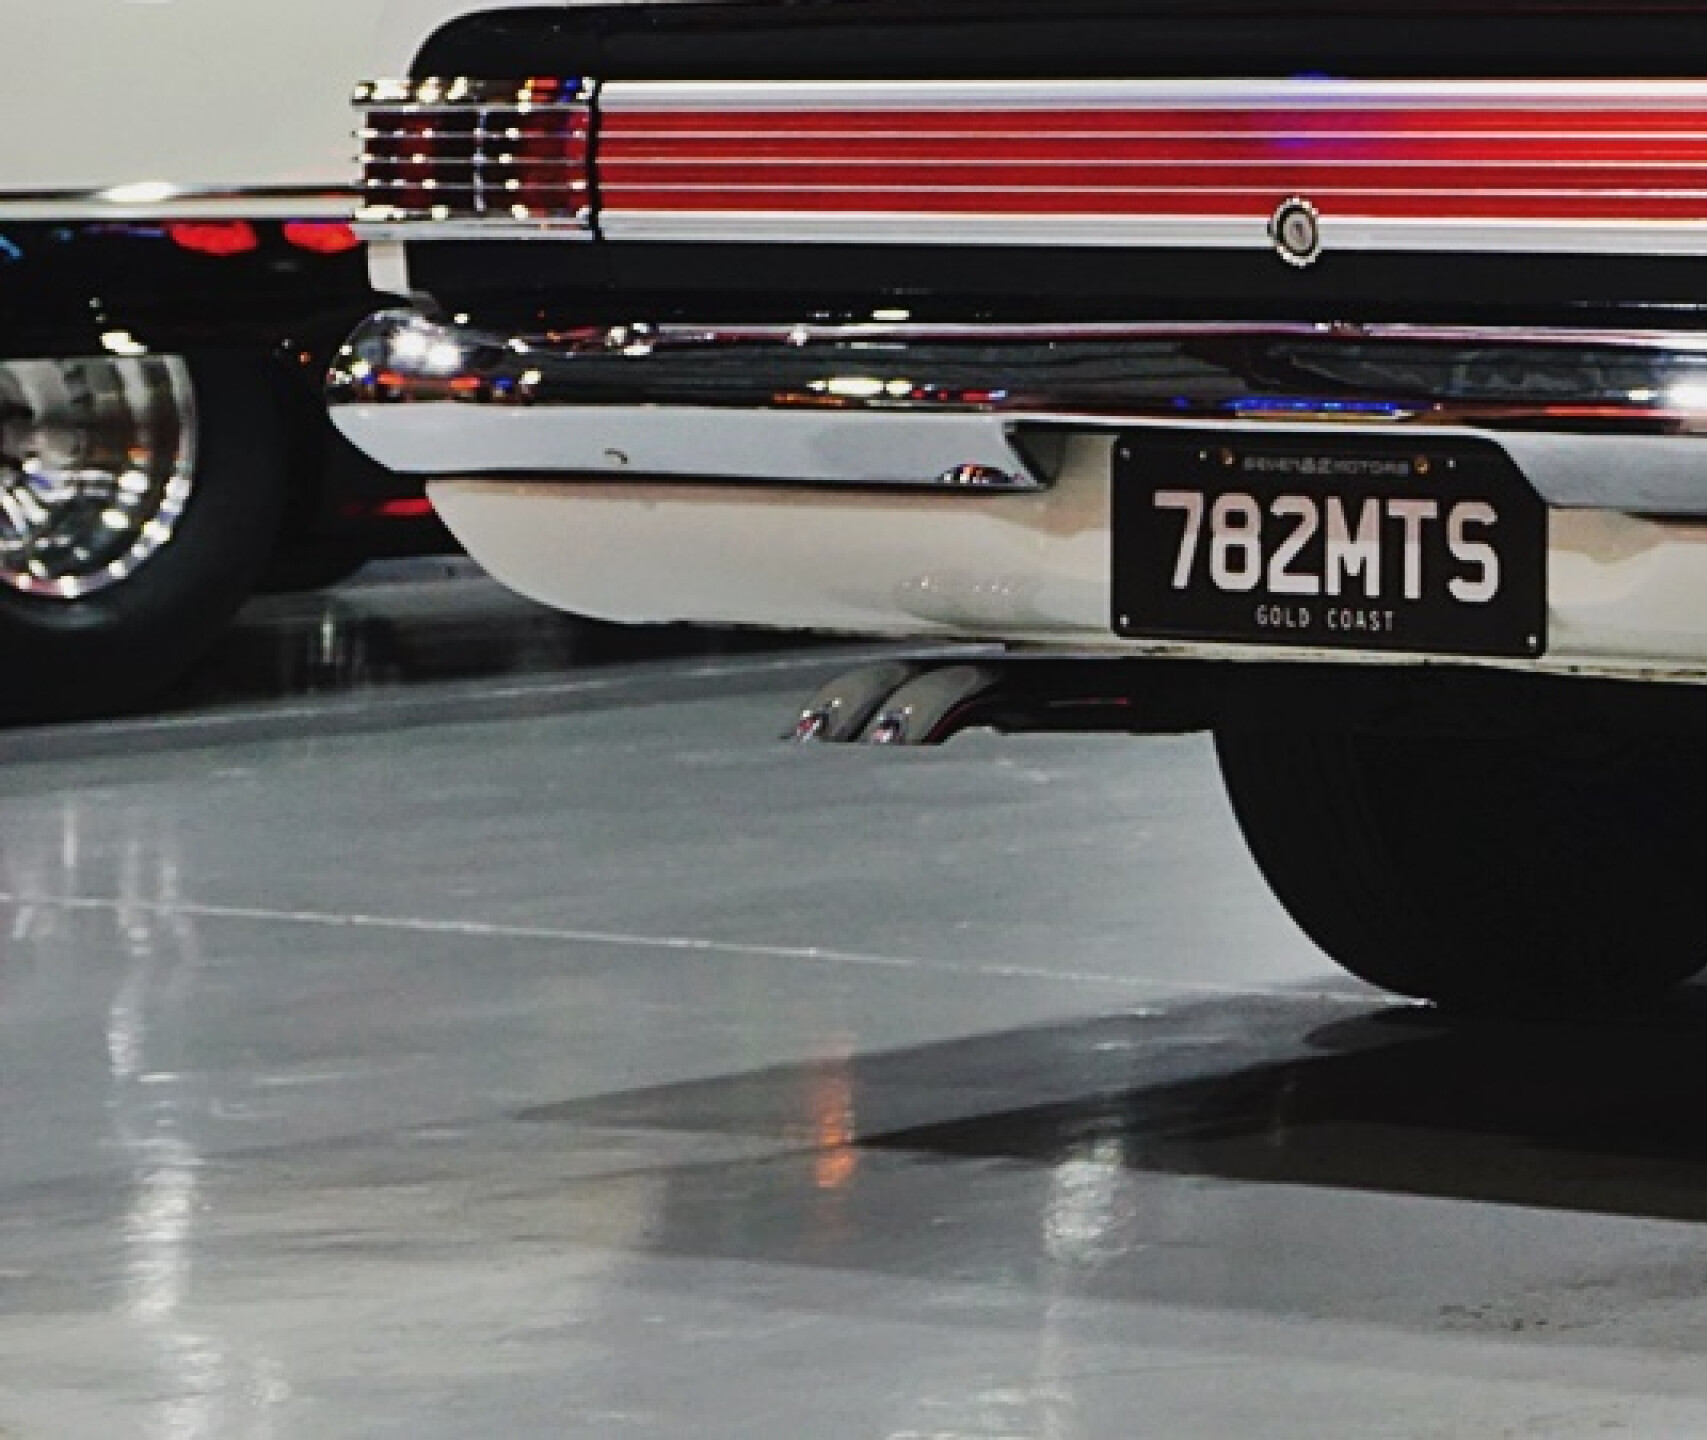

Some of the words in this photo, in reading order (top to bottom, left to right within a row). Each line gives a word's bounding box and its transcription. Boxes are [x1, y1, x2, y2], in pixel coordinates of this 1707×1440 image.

[1153, 489, 1499, 603] 782MTS
[1255, 603, 1311, 629] GOLD
[1326, 608, 1394, 632] COAST
